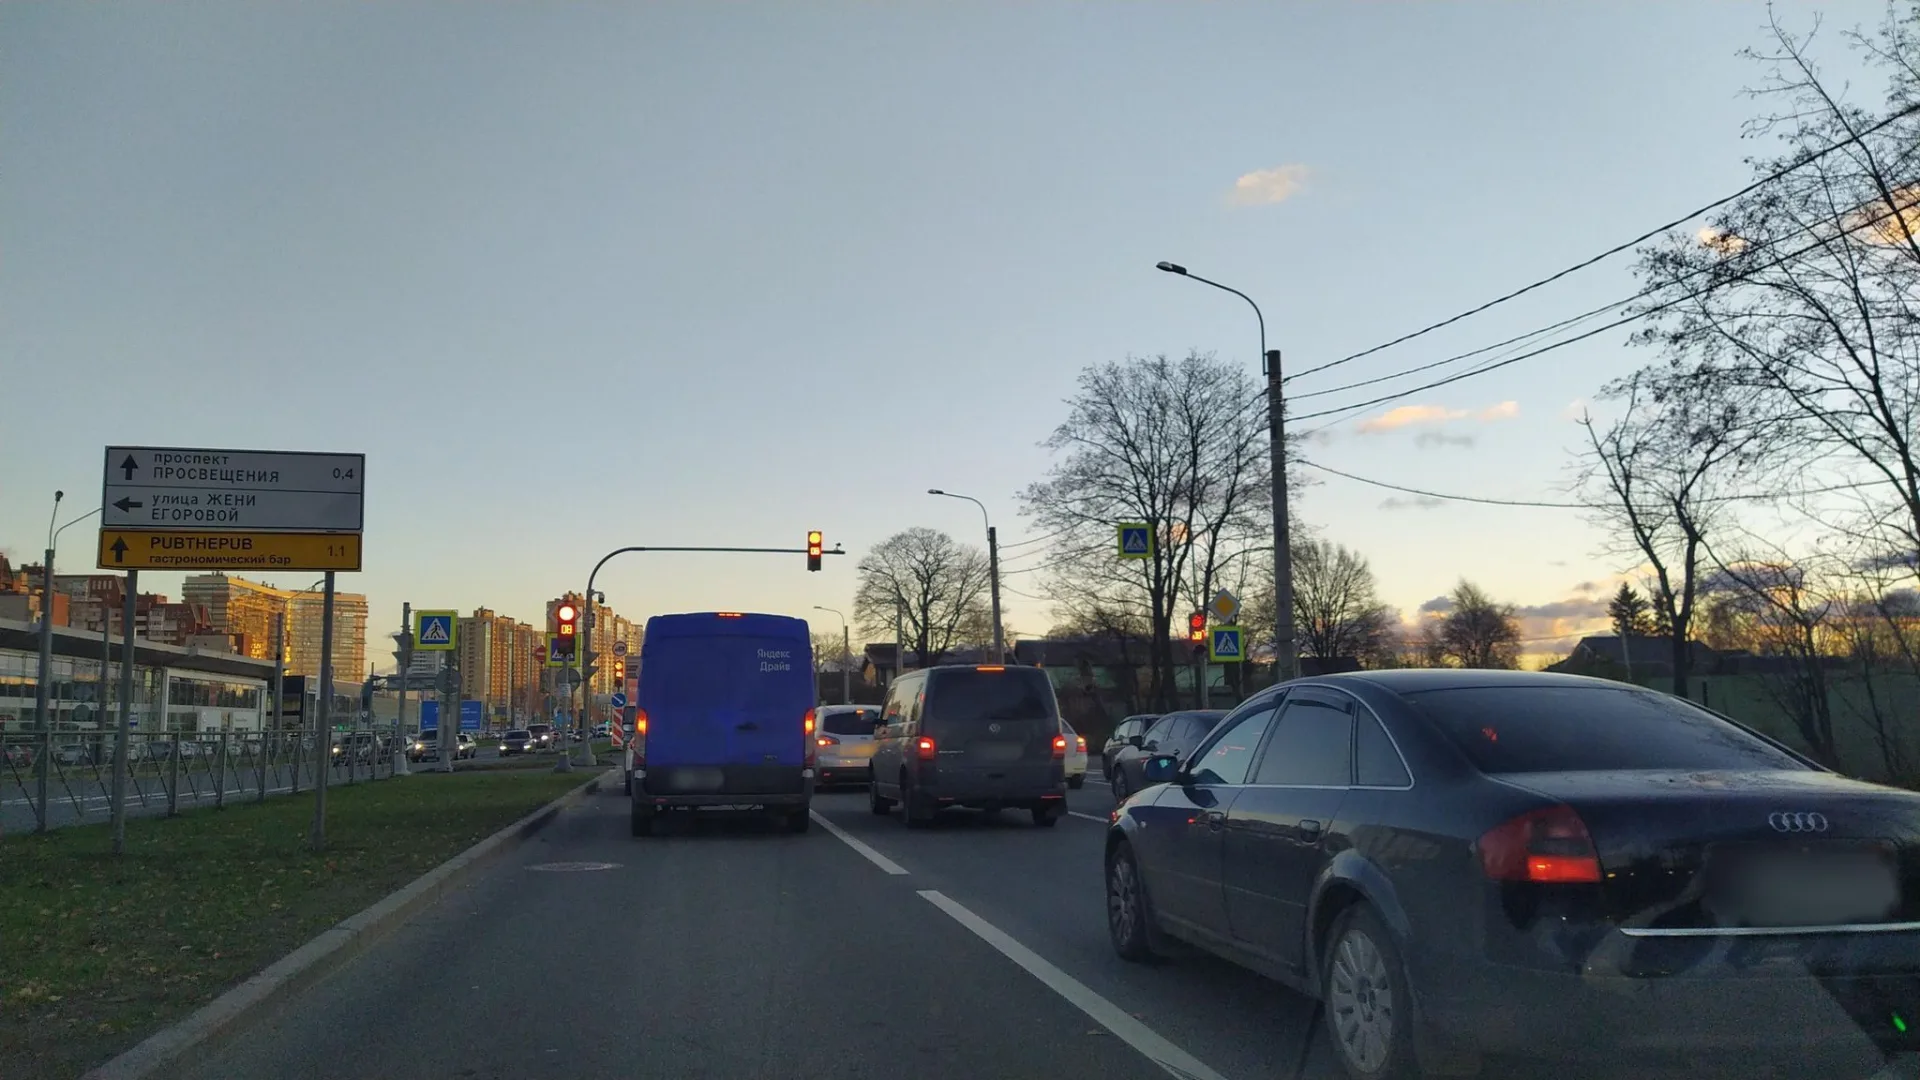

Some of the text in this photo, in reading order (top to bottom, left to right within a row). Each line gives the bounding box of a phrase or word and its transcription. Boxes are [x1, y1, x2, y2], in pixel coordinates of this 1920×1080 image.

[153, 452, 230, 465] проспект
[153, 466, 279, 484] ПРОСВЕЩЕНИЯ
[332, 467, 355, 481] 0,4
[152, 493, 256, 507] улица ЖЕНИ
[151, 507, 239, 523] ЕГОРОВОЙ
[150, 536, 253, 551] PUBTHEPUB
[327, 545, 346, 557] 1.1
[149, 554, 292, 566] гастрономический бар
[561, 624, 573, 635] 08
[757, 648, 791, 659] Яндекс
[760, 661, 791, 672] Драйв
